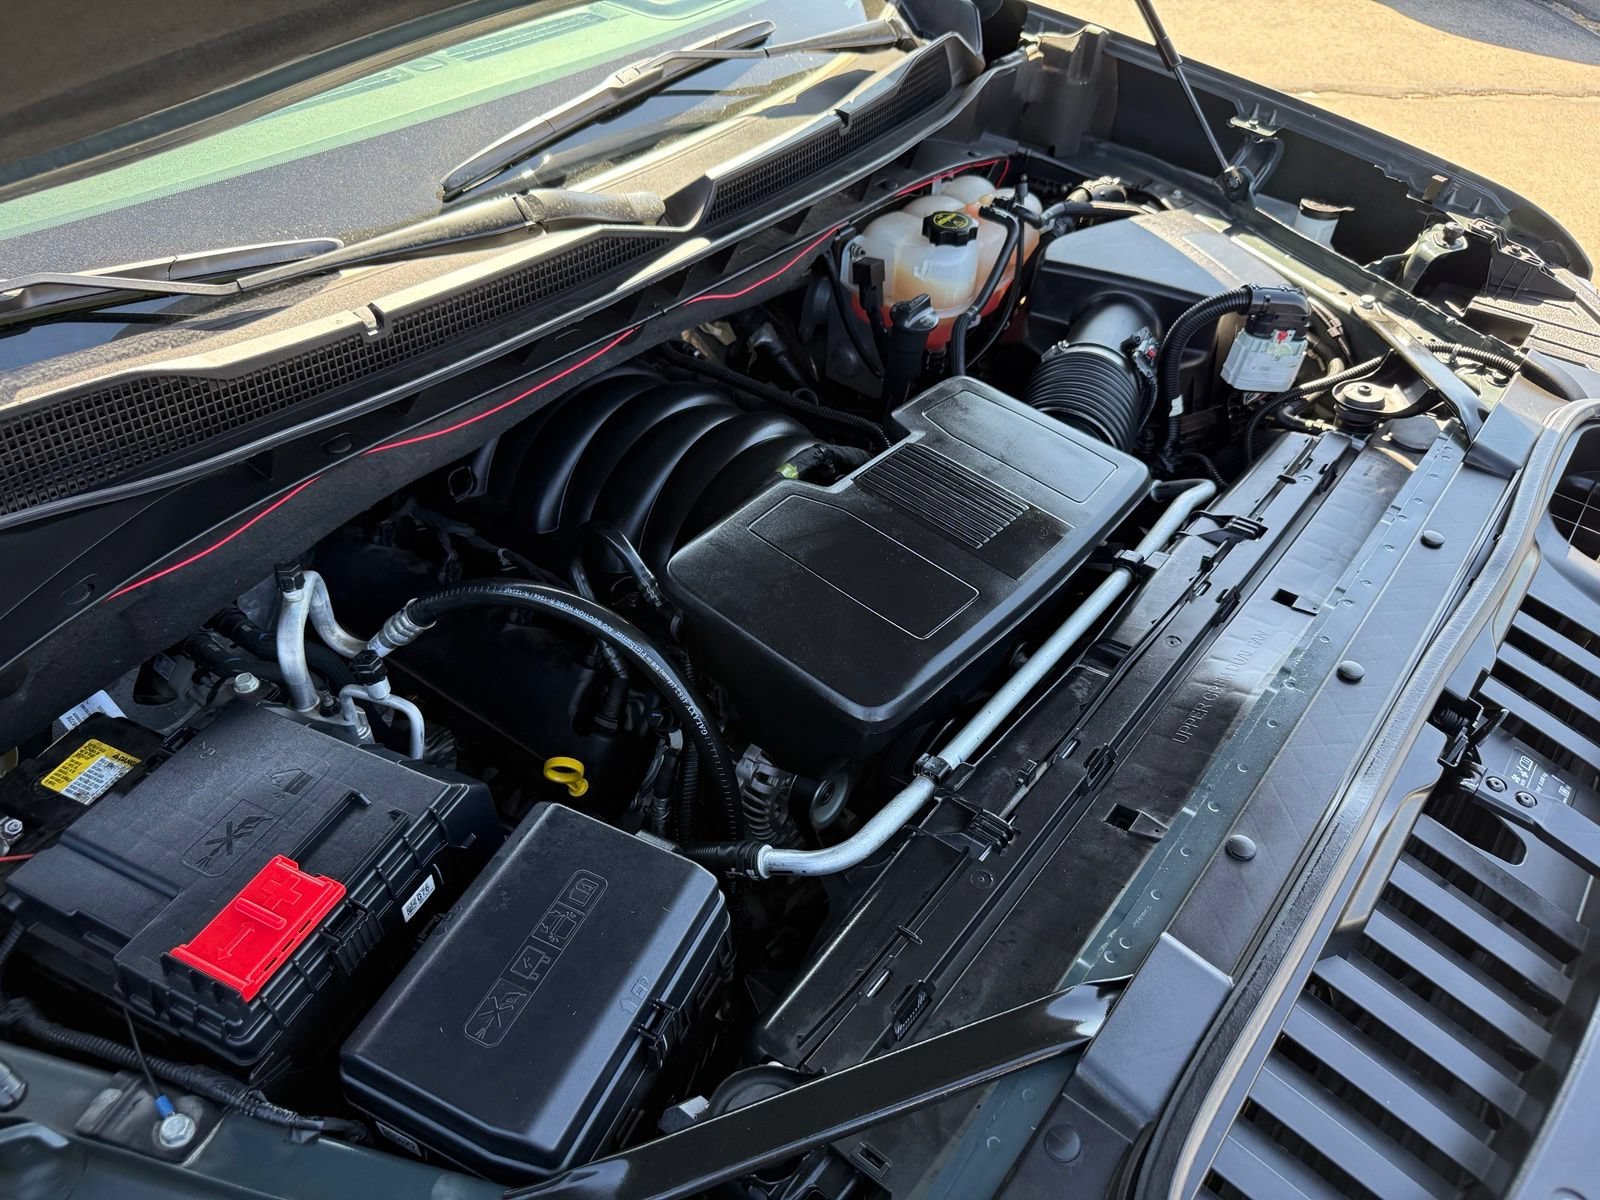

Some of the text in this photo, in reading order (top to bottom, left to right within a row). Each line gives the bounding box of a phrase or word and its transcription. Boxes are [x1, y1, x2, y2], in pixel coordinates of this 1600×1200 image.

[554, 599, 574, 611] HOSE
[573, 608, 602, 626] SUCTION
[601, 622, 614, 632] A/C
[1172, 699, 1214, 745] UPPER
[1225, 649, 1254, 673] DUAL
[1248, 629, 1269, 650] FAN
[685, 704, 708, 735] GALAXY
